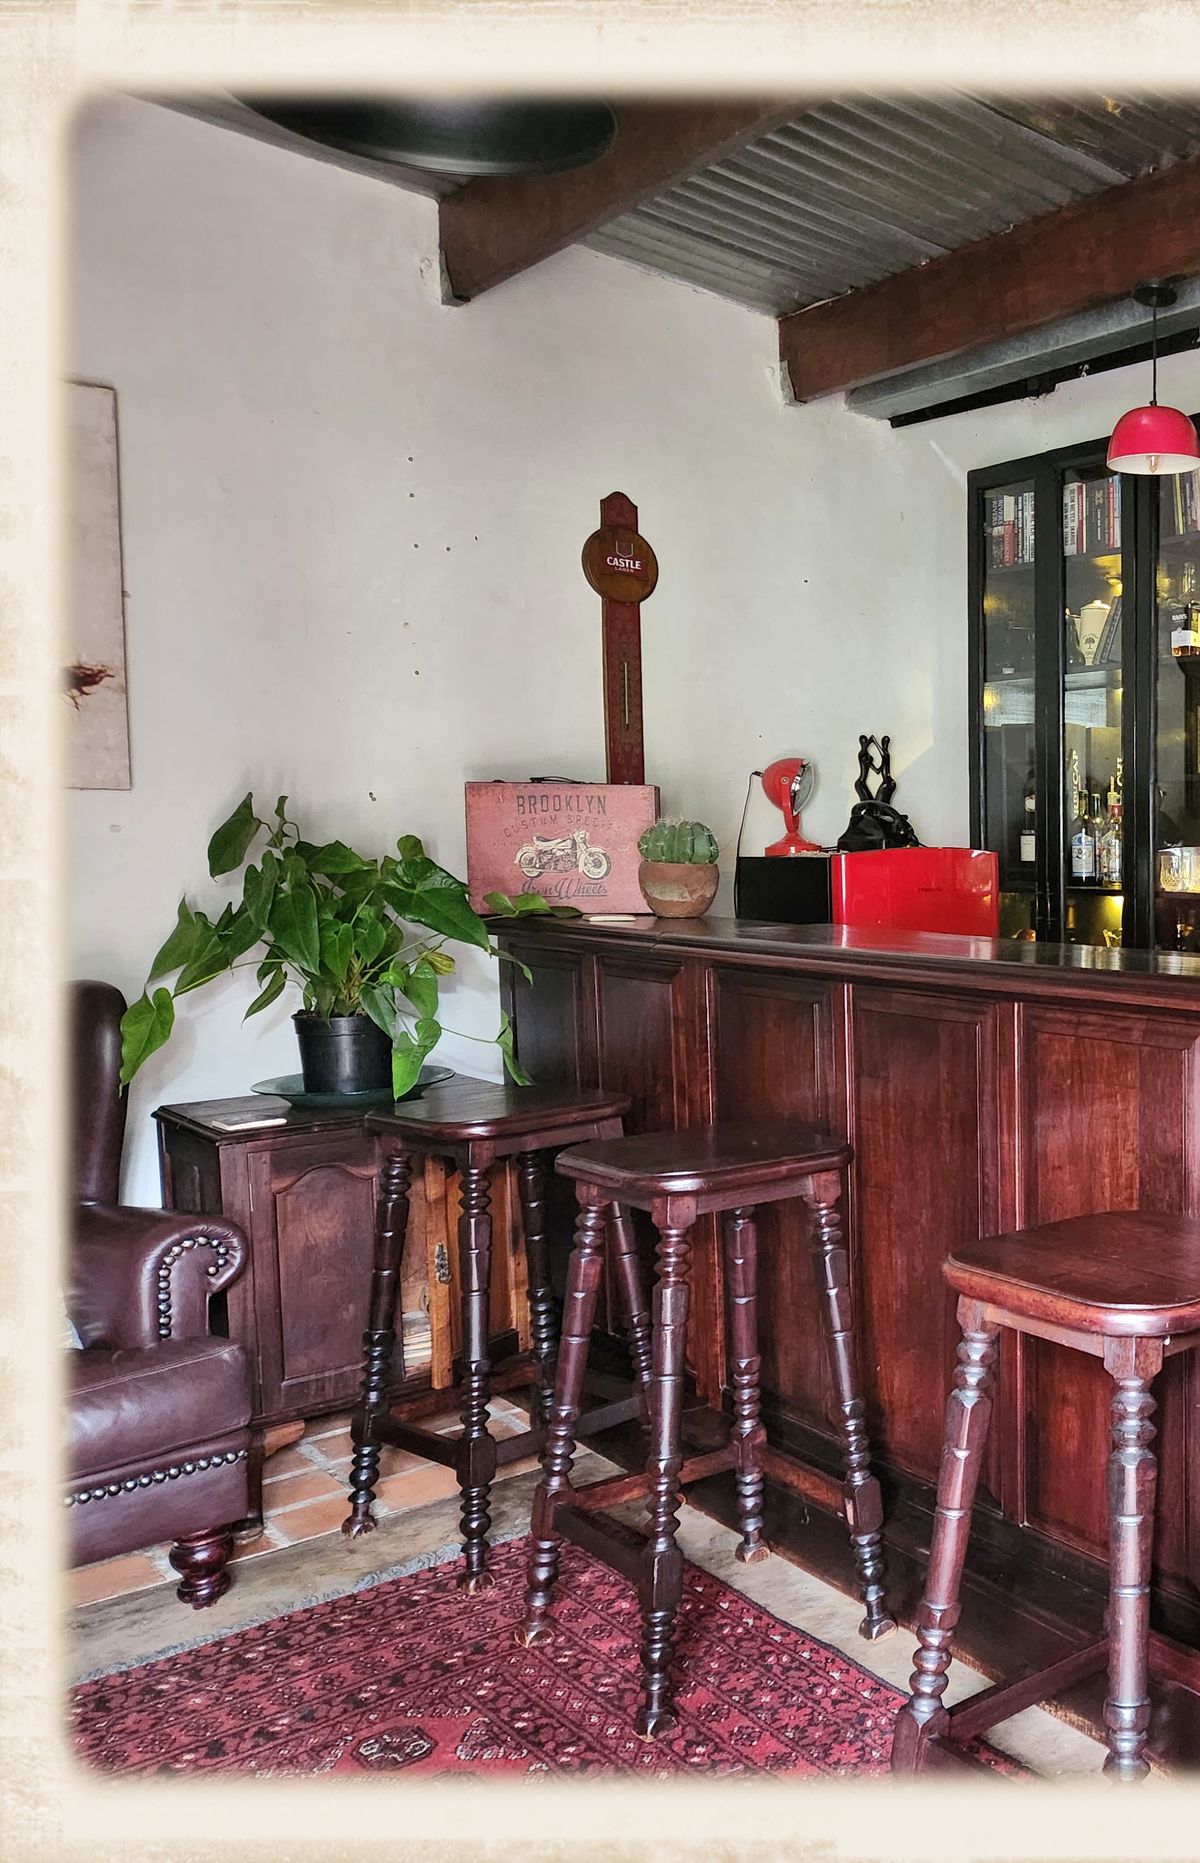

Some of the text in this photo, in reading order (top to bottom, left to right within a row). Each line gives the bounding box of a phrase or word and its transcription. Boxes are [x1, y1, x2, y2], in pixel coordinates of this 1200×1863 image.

[606, 556, 642, 570] CASTLE
[614, 566, 635, 574] LAGER
[516, 794, 607, 816] BROOKLYN
